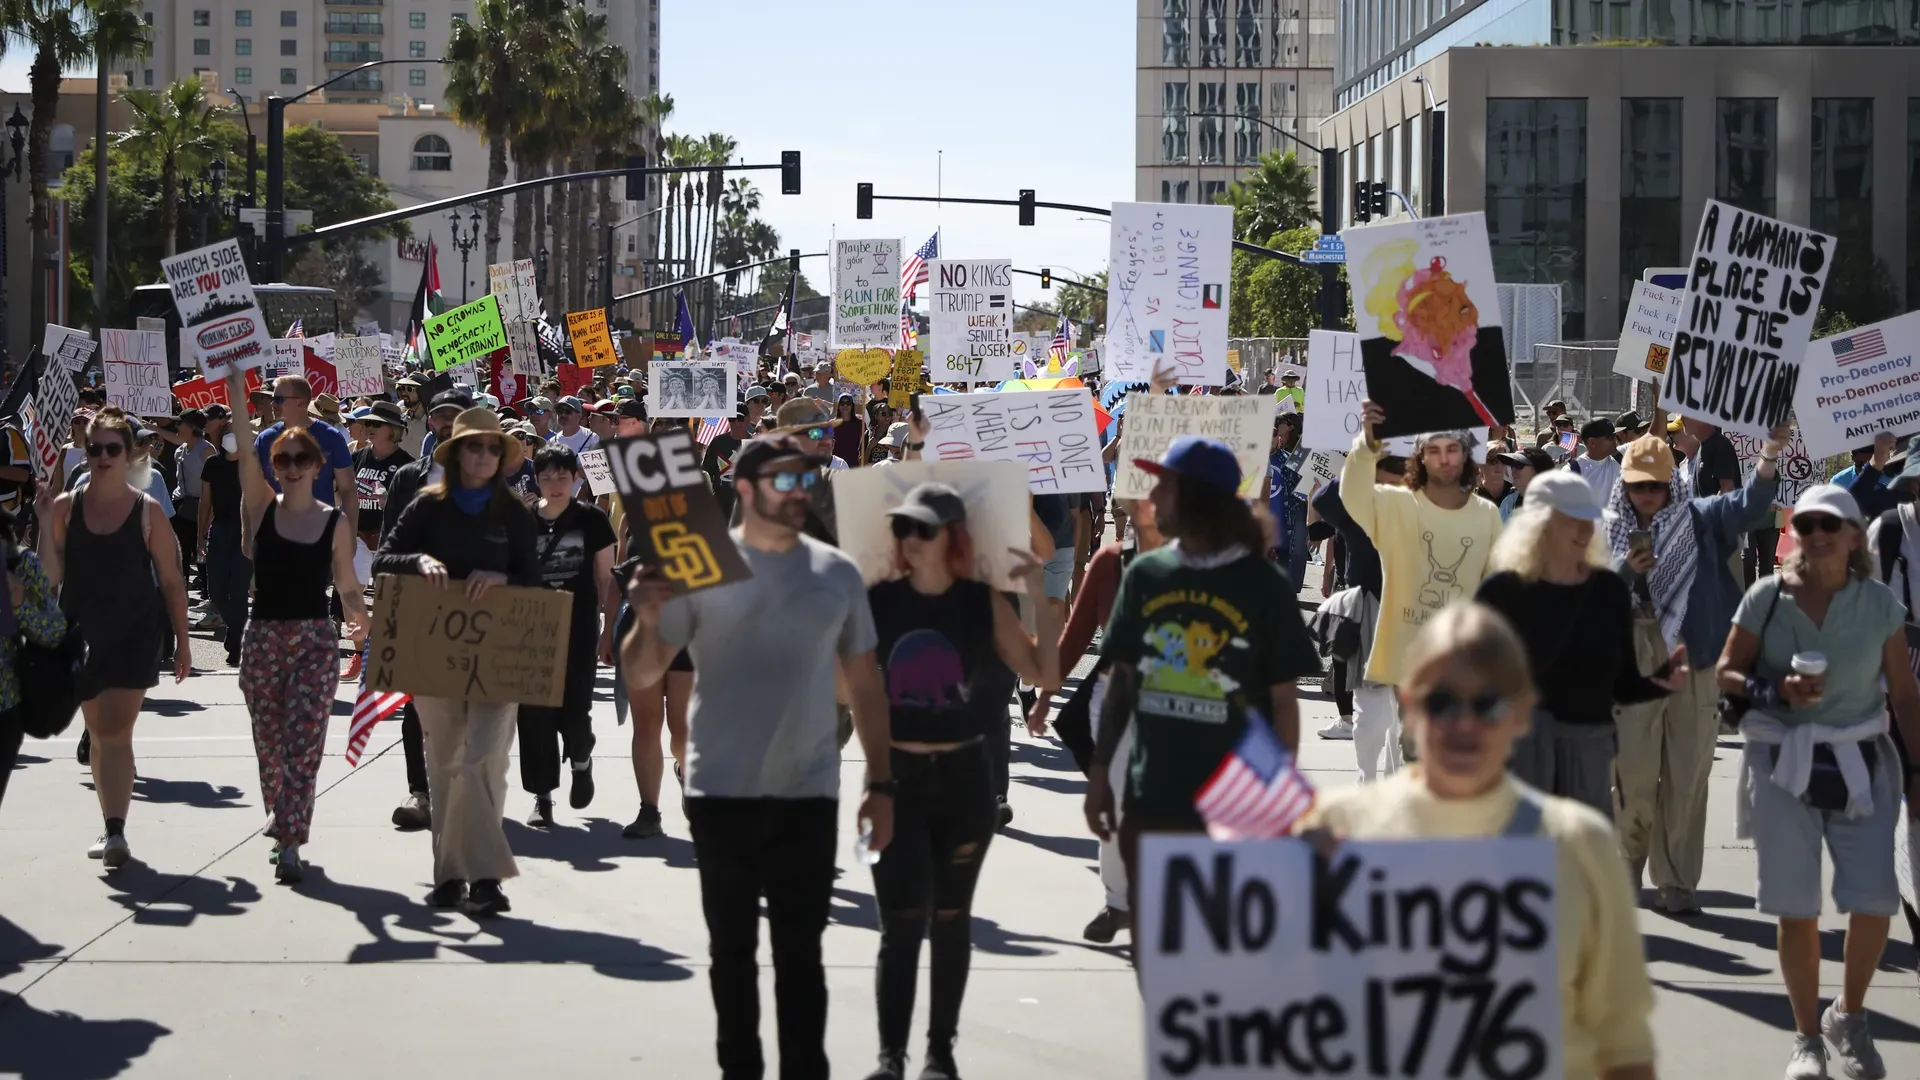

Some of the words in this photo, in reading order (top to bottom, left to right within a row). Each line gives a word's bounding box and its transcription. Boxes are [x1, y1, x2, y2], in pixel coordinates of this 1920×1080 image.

[1699, 204, 1719, 253] A
[166, 254, 209, 280] WHICH
[211, 245, 240, 268] SIDE
[839, 242, 870, 258] Maybe
[875, 242, 892, 254] it's
[845, 257, 864, 270] your
[940, 264, 967, 287] NO
[972, 264, 1012, 287] KINGS
[1177, 228, 1200, 300] CHANGE
[174, 279, 197, 300] ARE
[195, 271, 220, 294] YOU
[222, 264, 245, 285] ON?
[855, 275, 869, 287] to
[1690, 257, 1768, 304] PLACE
[1779, 274, 1821, 316] IS
[844, 288, 872, 304] RUN
[876, 287, 898, 302] FOR
[935, 292, 984, 312] TRUMP
[1642, 287, 1665, 302] Fuck
[429, 324, 444, 340] NO
[447, 302, 486, 327] CROWNS
[840, 304, 898, 318] SOMETHING
[1637, 304, 1659, 319] Fuck
[1690, 296, 1722, 335] IN
[1735, 305, 1789, 349] THE
[200, 326, 228, 347] WORKING
[230, 321, 252, 337] CLASS
[437, 320, 491, 357] DEMOCRACY!
[451, 326, 460, 335] IN
[1632, 321, 1653, 336] Fuck
[106, 331, 126, 362] NO
[128, 332, 160, 363] ONE
[336, 346, 379, 361] SATURDAYS
[350, 338, 362, 346] ON
[445, 357, 456, 366] NO
[458, 332, 499, 359] TYRANNY
[1172, 318, 1205, 378] POLICY
[106, 364, 118, 383] IS
[124, 364, 166, 388] ILLEGAL
[274, 358, 300, 369] Justice
[345, 368, 372, 378] FIGHT
[352, 359, 366, 368] WE
[946, 354, 983, 376] 8647
[1652, 358, 1664, 368] NO
[1820, 355, 1912, 388] Pro-Decency
[50, 352, 78, 414] WHICH
[128, 386, 144, 397] ON
[338, 375, 384, 398] FASCISM
[42, 374, 72, 440] SIDE
[1008, 403, 1042, 430] IS
[1048, 393, 1083, 422] NO
[1130, 396, 1158, 415] THE
[1165, 398, 1214, 416] ENEMY
[1219, 398, 1259, 416] WITHIN
[36, 397, 61, 453] ARE
[972, 397, 1008, 452] WHEN
[1130, 416, 1143, 432] IS
[1147, 418, 1164, 434] IN
[1170, 418, 1194, 434] THE
[1200, 418, 1242, 434] WHITE
[32, 417, 57, 467] YOU
[607, 432, 703, 495] ICE
[1059, 434, 1095, 479] ONE
[1311, 452, 1330, 467] FREE
[357, 468, 388, 481] GIRLS
[428, 605, 492, 645] 50!
[445, 654, 487, 696] YES
[1159, 852, 1277, 955] No
[1309, 852, 1552, 976] Kings
[1363, 977, 1548, 1080] 1776
